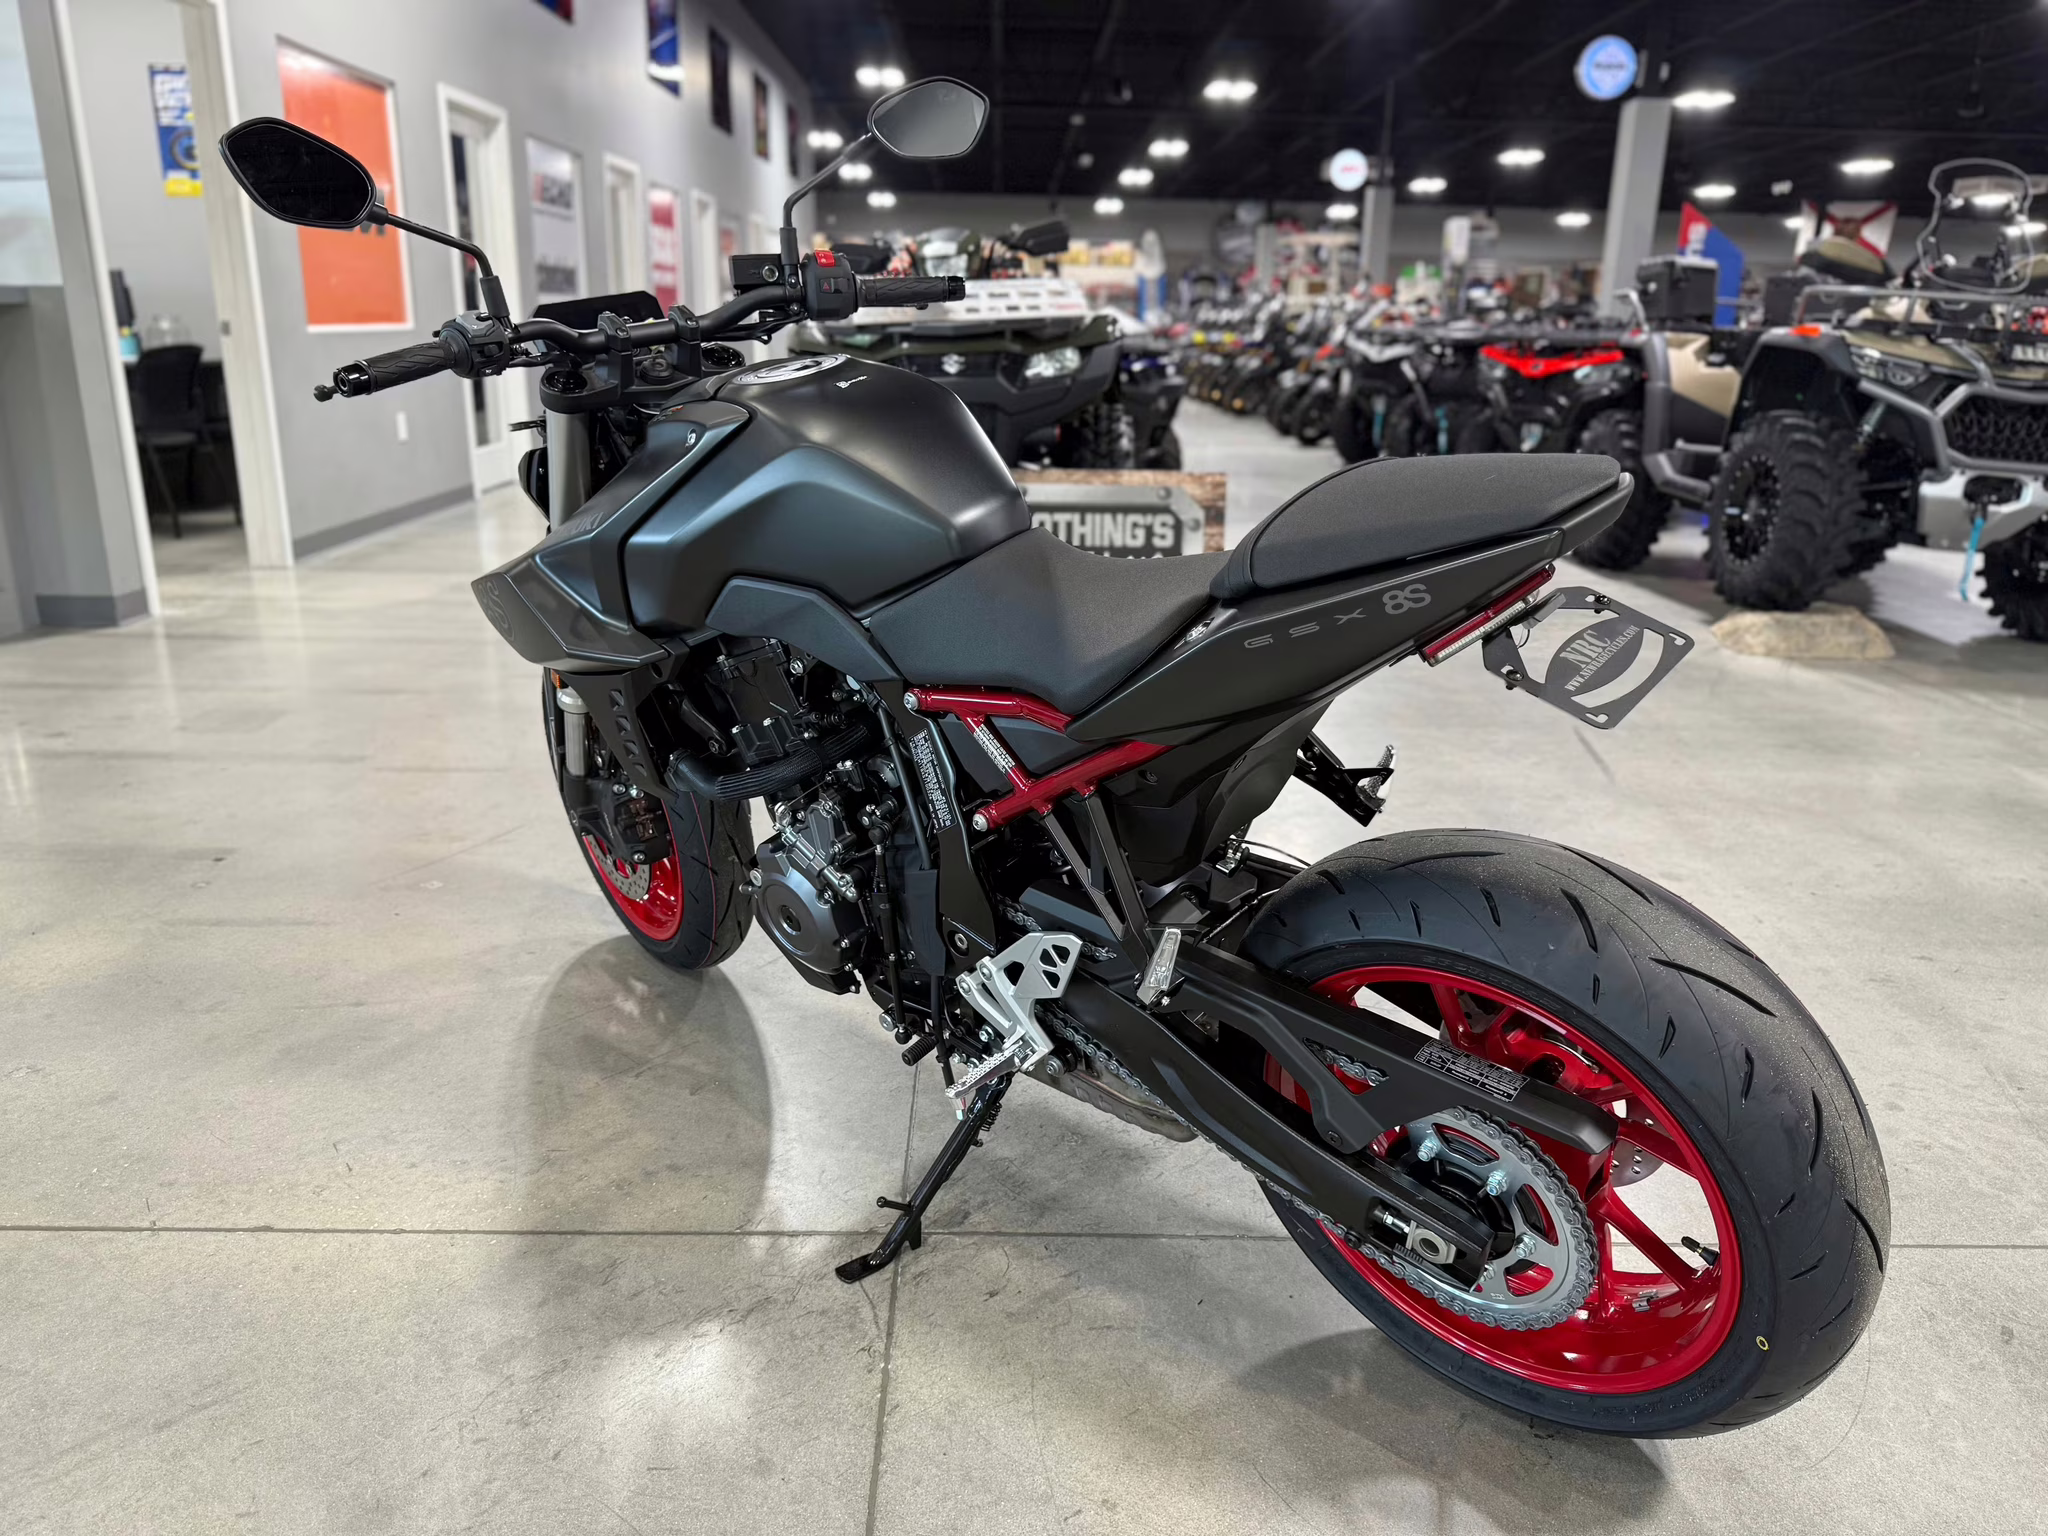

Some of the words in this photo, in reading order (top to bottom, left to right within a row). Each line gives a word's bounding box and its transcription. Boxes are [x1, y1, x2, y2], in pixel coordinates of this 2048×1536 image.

[1031, 511, 1175, 548] OTHING'S
[1382, 583, 1431, 614] 8S
[1559, 629, 1611, 668] NRC
